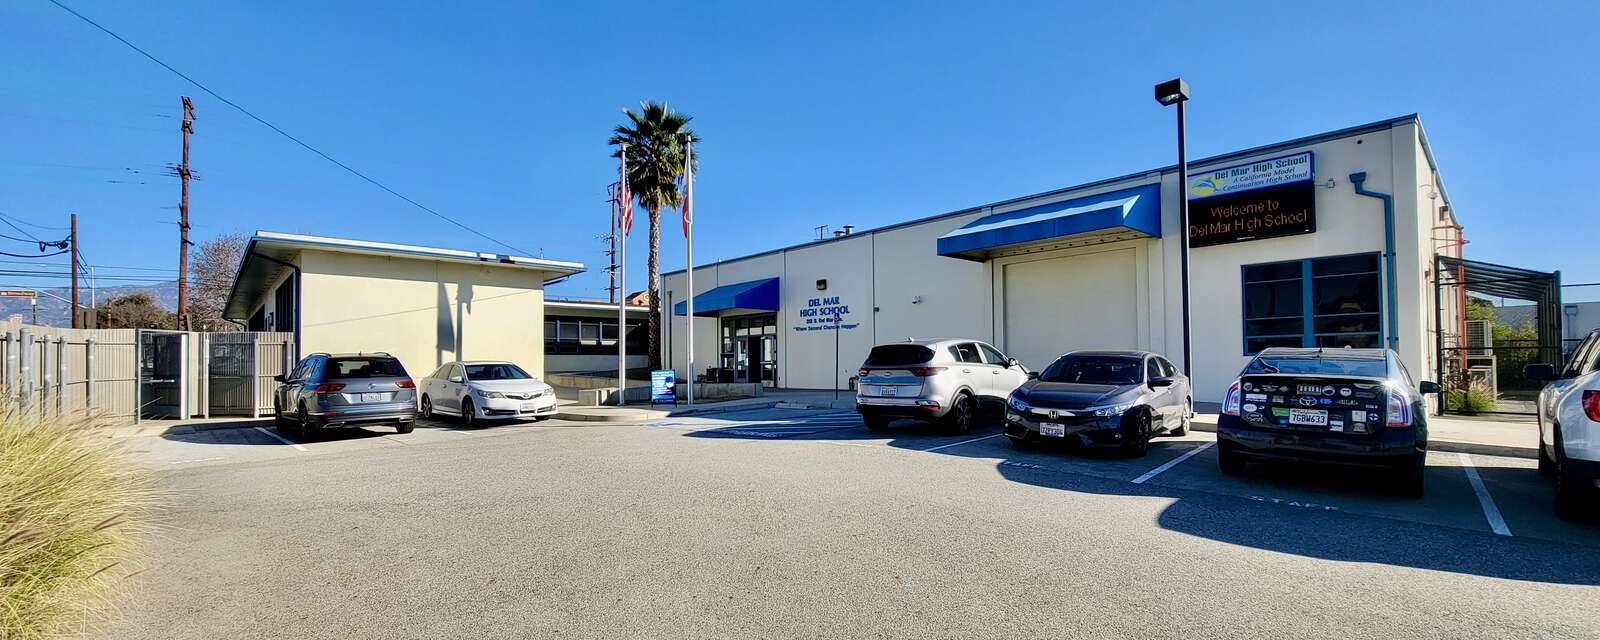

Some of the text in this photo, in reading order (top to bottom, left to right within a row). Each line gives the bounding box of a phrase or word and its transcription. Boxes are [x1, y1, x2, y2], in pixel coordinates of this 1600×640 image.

[1215, 155, 1307, 180] Del Mar High School
[1240, 172, 1272, 182] California
[1273, 167, 1295, 176] Model
[1222, 171, 1308, 192] Continuation High School
[1211, 200, 1279, 218] Welcome to
[1189, 209, 1307, 238] Del Mar Hgh School
[808, 296, 840, 307] DEL MAR
[800, 305, 850, 317] HIGH SCHOOL
[1291, 413, 1325, 423] 7GBW633
